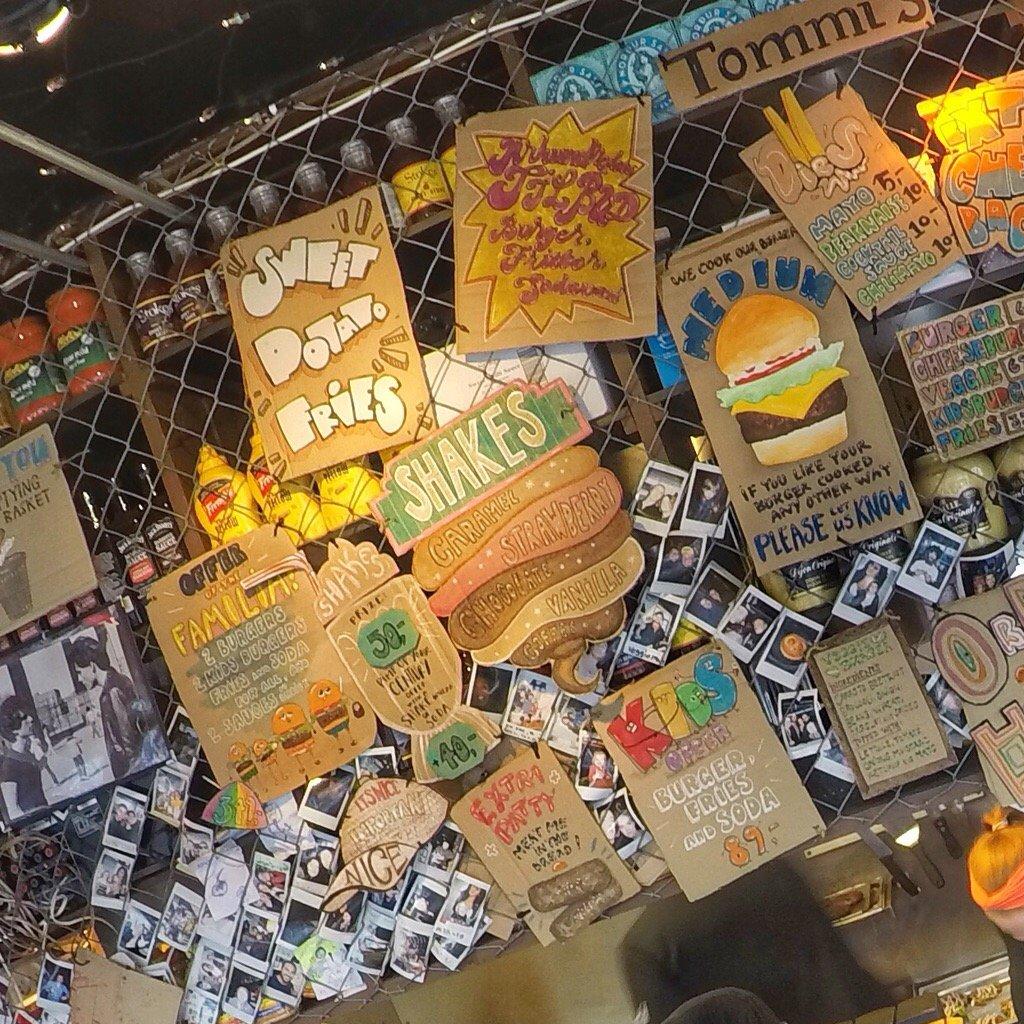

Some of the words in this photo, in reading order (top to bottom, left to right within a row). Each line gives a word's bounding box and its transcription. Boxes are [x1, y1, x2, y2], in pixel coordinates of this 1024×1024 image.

[809, 186, 874, 241] MAYO
[241, 237, 380, 318] SWEET
[670, 269, 696, 287] WE
[698, 252, 733, 276] COOK
[680, 256, 837, 362] MEDIUM
[903, 303, 1004, 357] BURGER
[252, 294, 389, 387] POTATO
[274, 374, 406, 453] FRIES
[920, 361, 1003, 406] VEGGIE
[394, 391, 546, 522] SHAKES
[937, 414, 1002, 448] FRIES
[740, 484, 757, 503] IF
[759, 473, 789, 494] YOU
[792, 458, 825, 485] LIKE
[829, 440, 873, 466] YOUR
[753, 483, 811, 513] BURGER
[817, 455, 875, 488] COOKED
[770, 502, 801, 524] ANY
[805, 483, 853, 511] OTHER
[854, 464, 893, 488] WAY
[428, 489, 520, 568] CARAMEL
[500, 477, 615, 566] STRAWBERRY
[752, 510, 830, 562] PLEASE
[855, 480, 912, 528] KNOW
[546, 562, 626, 616] VANILLA
[203, 658, 239, 688] KIDS
[240, 617, 309, 665] BURGERS
[216, 605, 287, 657] BURGERS
[270, 641, 310, 670] SODA
[223, 692, 279, 736] SAUCES
[607, 652, 738, 772] KIDS
[683, 772, 754, 824] FRIES
[684, 825, 717, 852] AND
[716, 786, 780, 834] SODA
[345, 844, 408, 888] NICE
